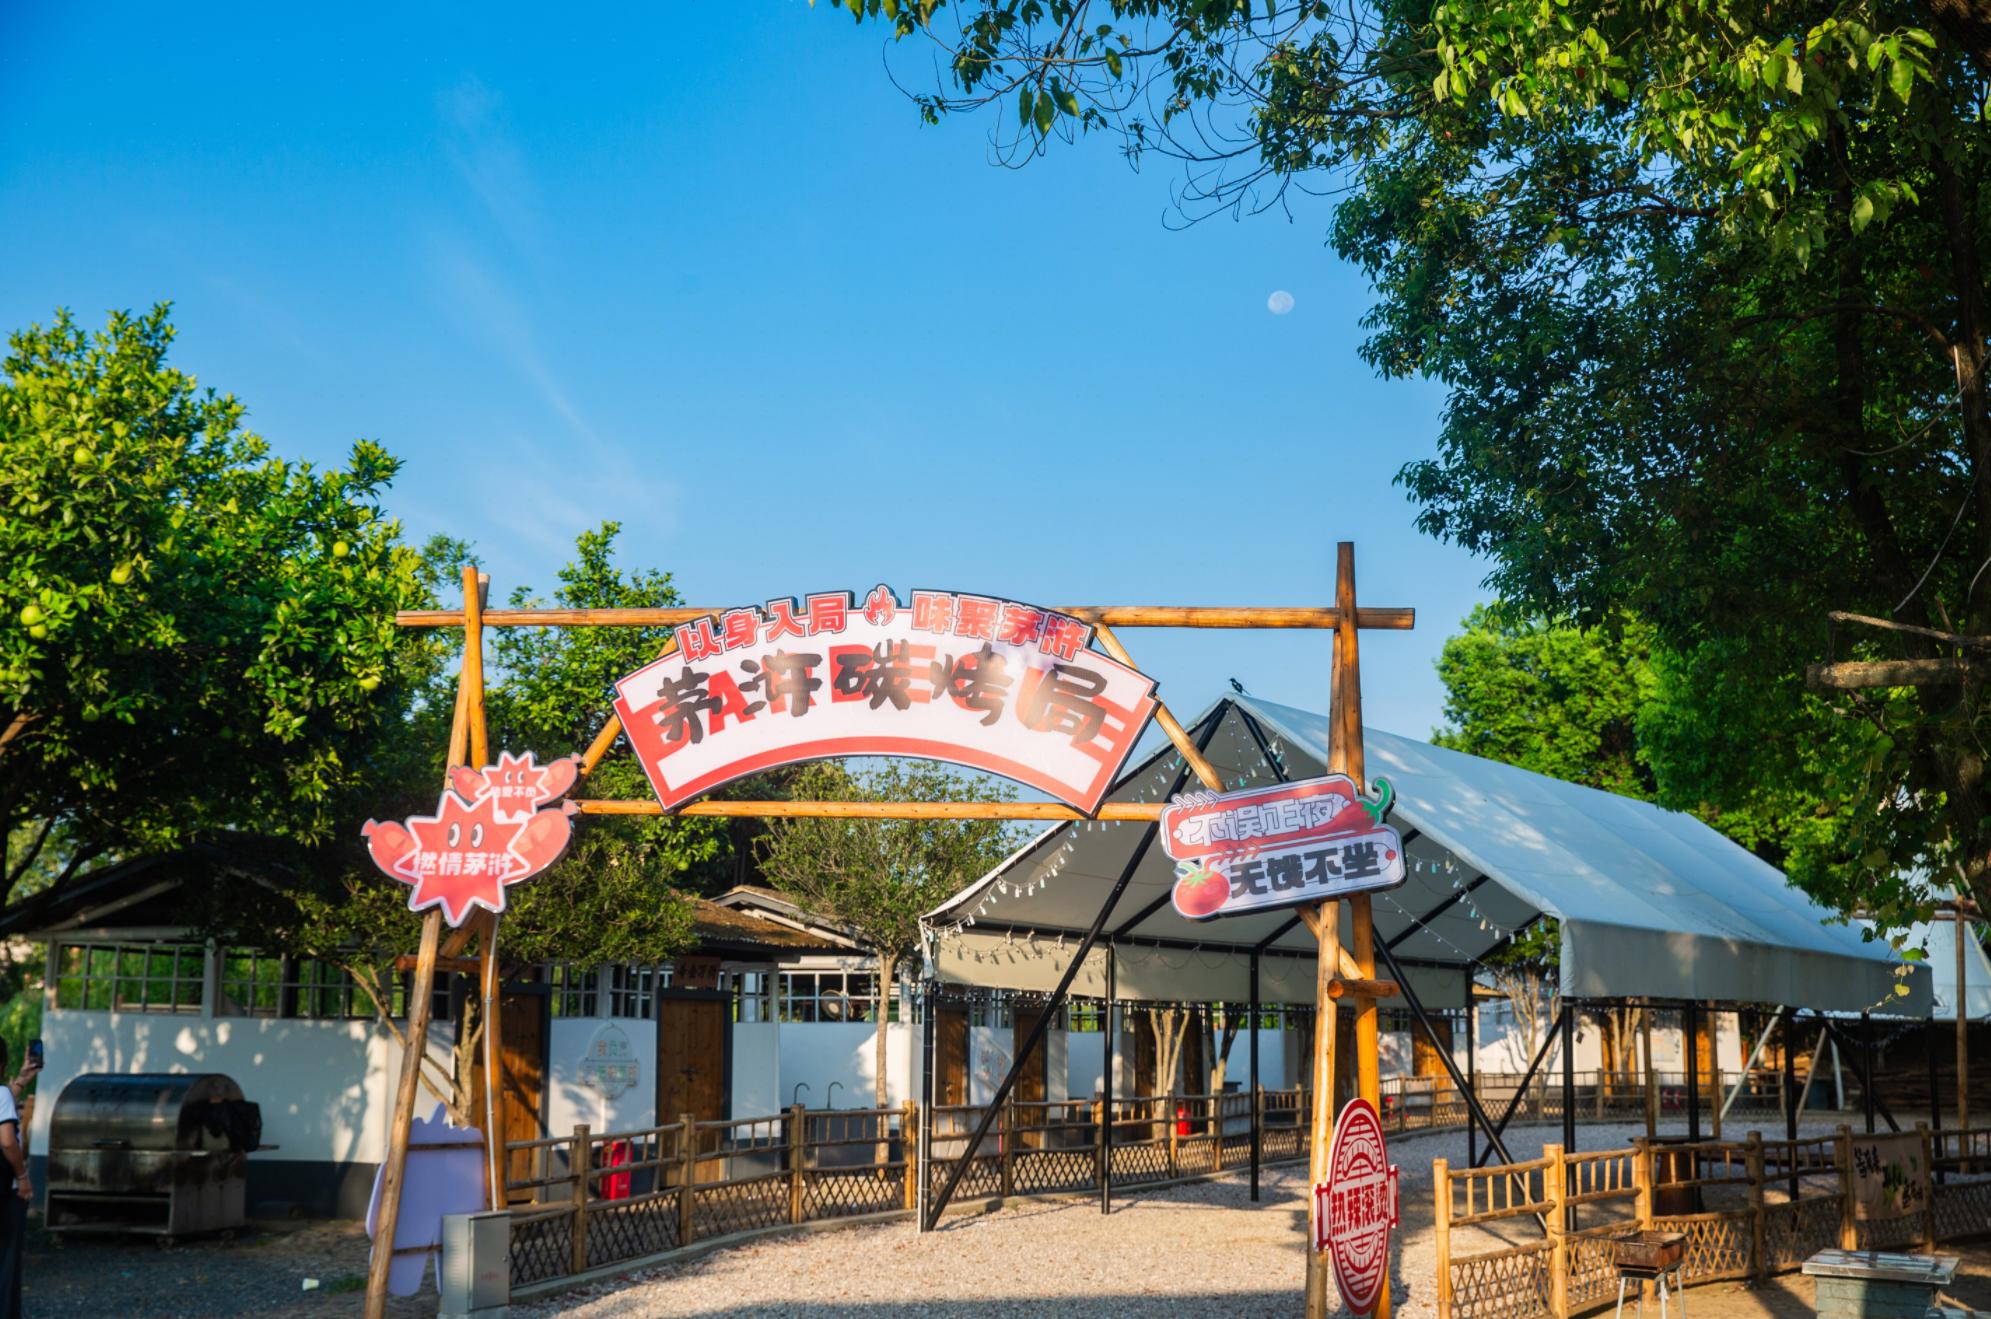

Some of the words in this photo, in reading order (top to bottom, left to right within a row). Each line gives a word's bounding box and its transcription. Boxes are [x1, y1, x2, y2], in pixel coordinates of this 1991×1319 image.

[680, 593, 848, 661] 以身入局
[912, 591, 1083, 660] 味聚茅浒
[657, 639, 1108, 745] 茅浒碳烤局
[1331, 1181, 1389, 1237] 热辣滚烫
